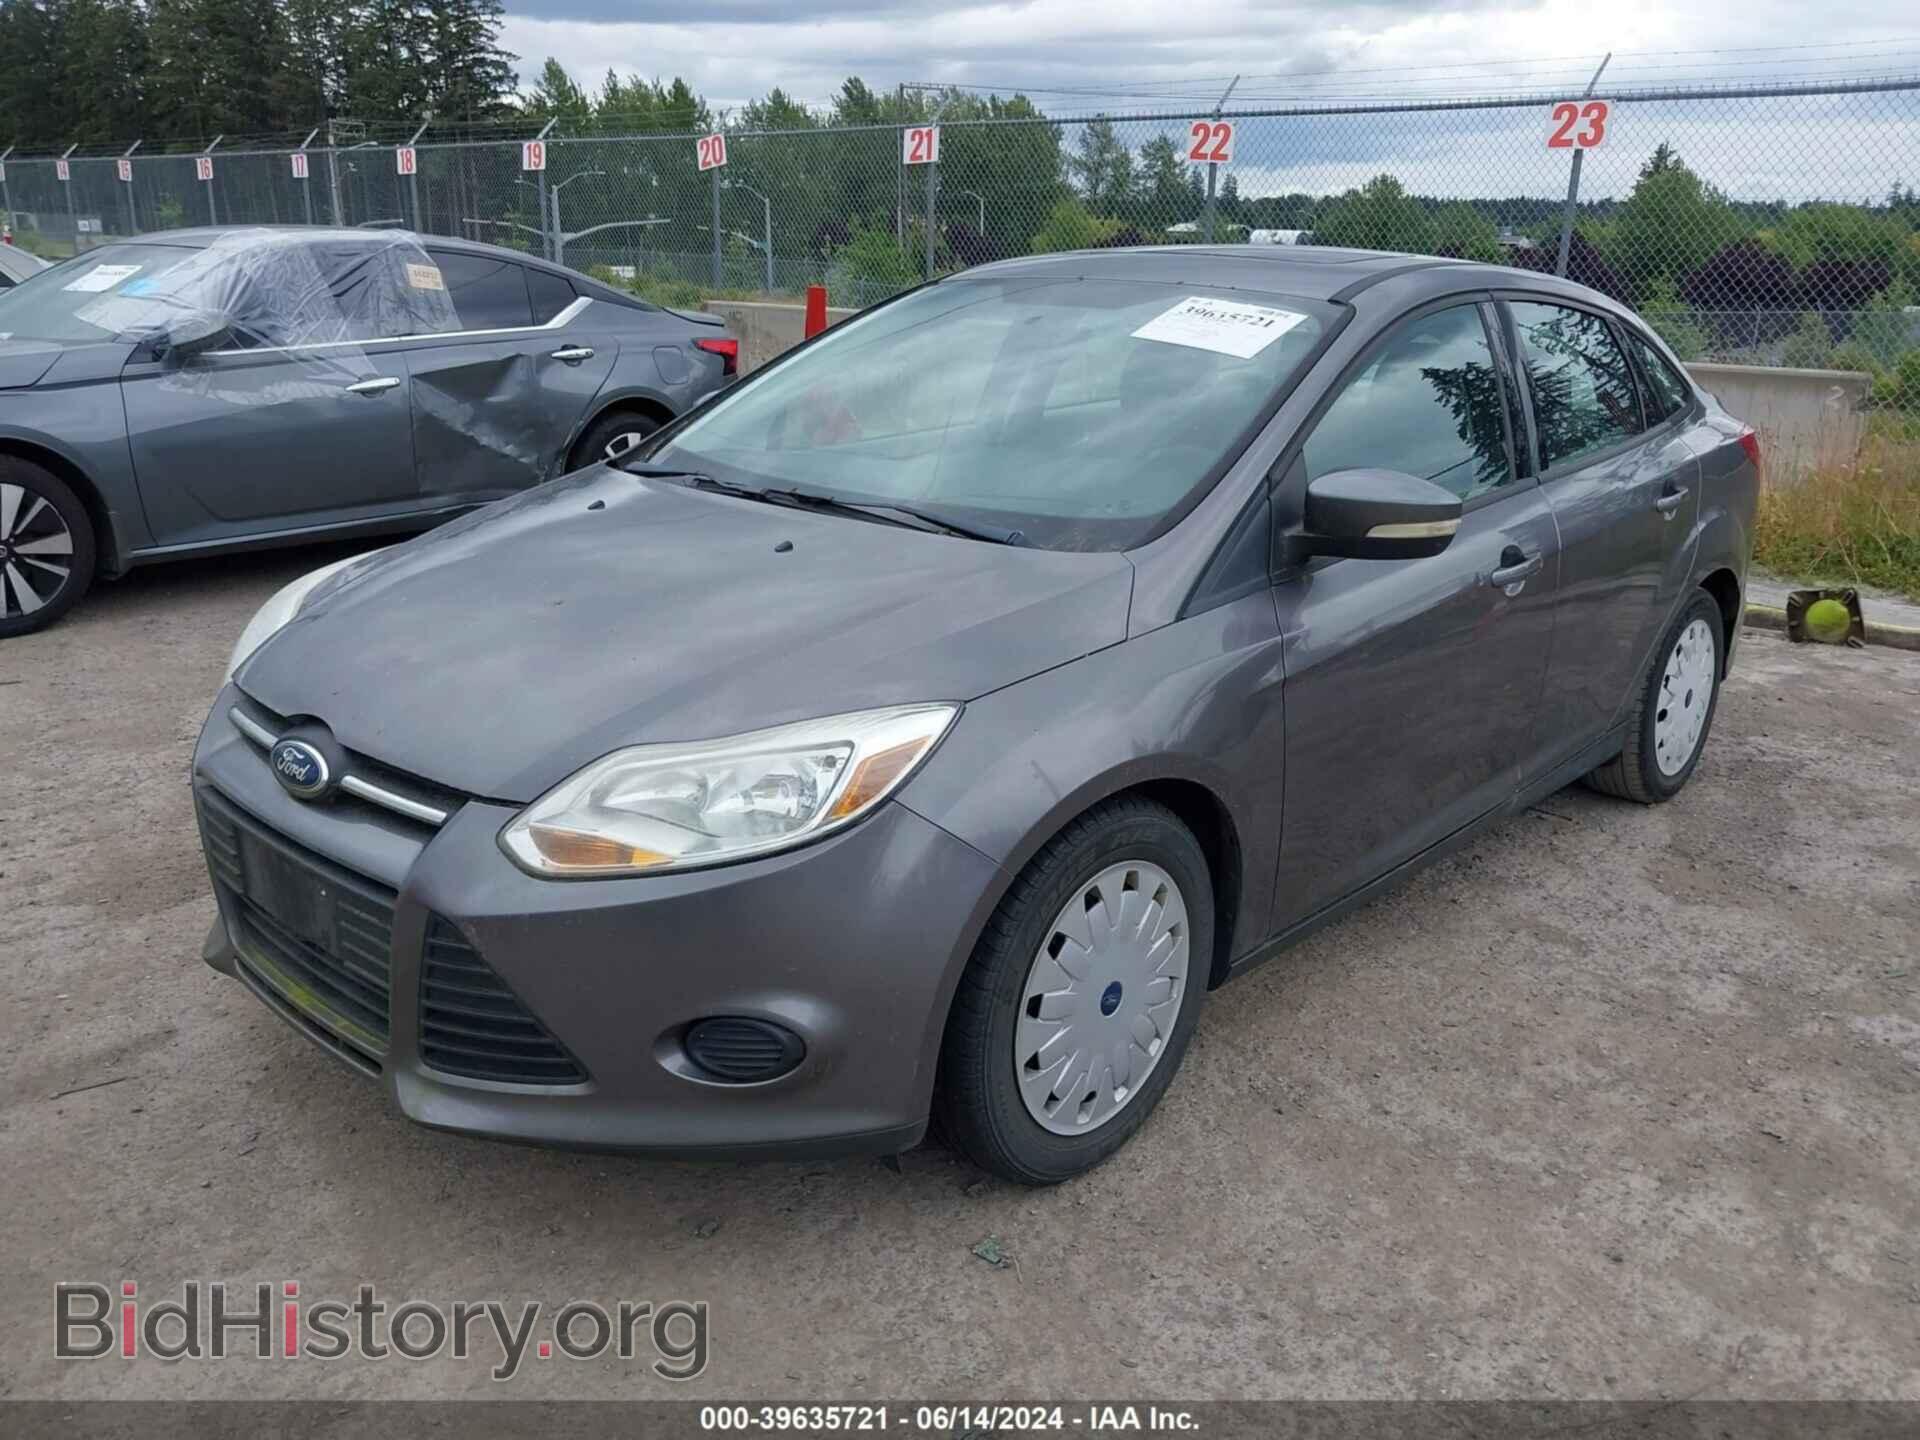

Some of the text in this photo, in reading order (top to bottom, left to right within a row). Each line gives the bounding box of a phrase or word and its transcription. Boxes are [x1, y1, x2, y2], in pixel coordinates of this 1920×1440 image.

[1547, 101, 1608, 147] 23
[526, 143, 543, 169] 19
[699, 135, 724, 168] 20
[909, 128, 934, 162] 21
[1189, 122, 1232, 161] 22
[199, 158, 211, 178] 16
[294, 155, 305, 176] 17
[399, 149, 414, 173] 18
[276, 746, 312, 781] Ford
